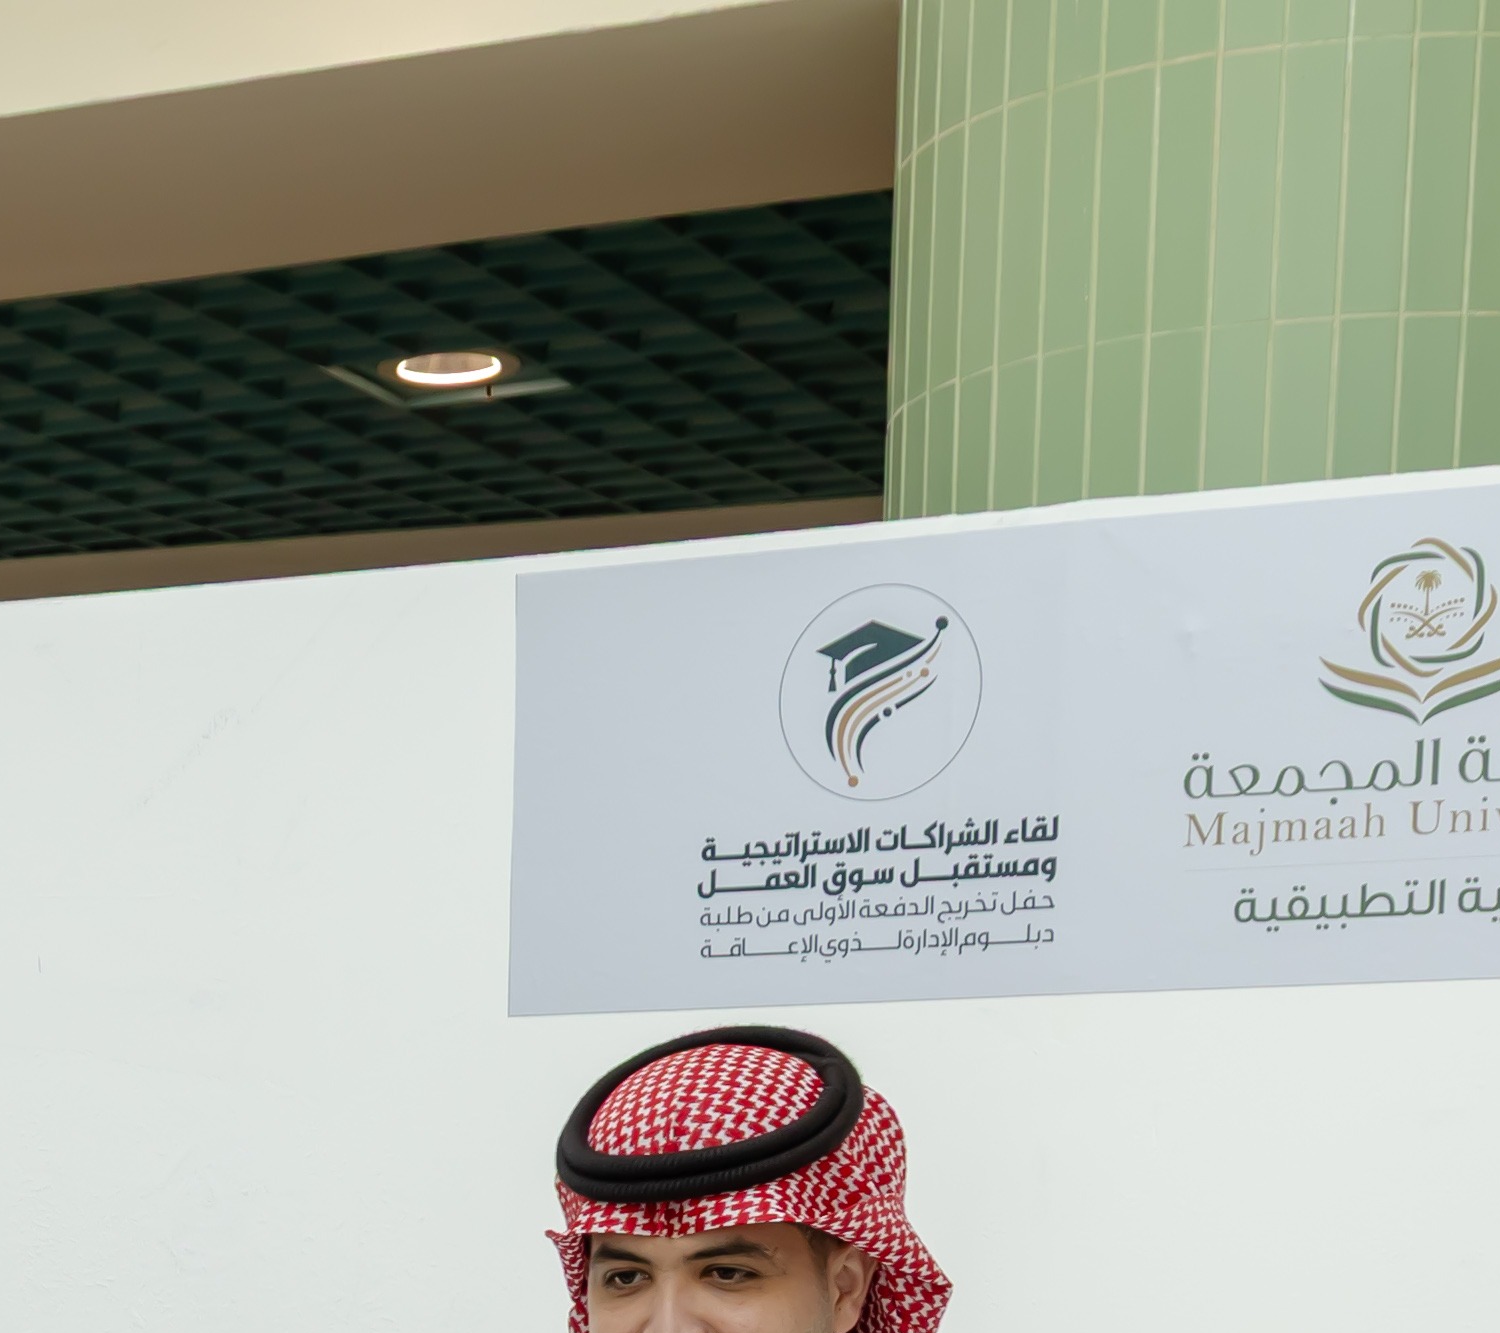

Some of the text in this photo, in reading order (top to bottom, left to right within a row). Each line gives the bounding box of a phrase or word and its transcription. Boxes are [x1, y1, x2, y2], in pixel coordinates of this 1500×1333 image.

[1183, 737, 1441, 806] المجمعة
[700, 814, 1060, 867] لقاء الشراكات الاستراتيجية
[1183, 803, 1387, 856] Majmaah
[697, 853, 1058, 899] ومستقبل سوق العمل
[699, 889, 1056, 932] حفل تخريج الدفعة الأولى من طلبة
[1233, 877, 1447, 933] التطبيقية
